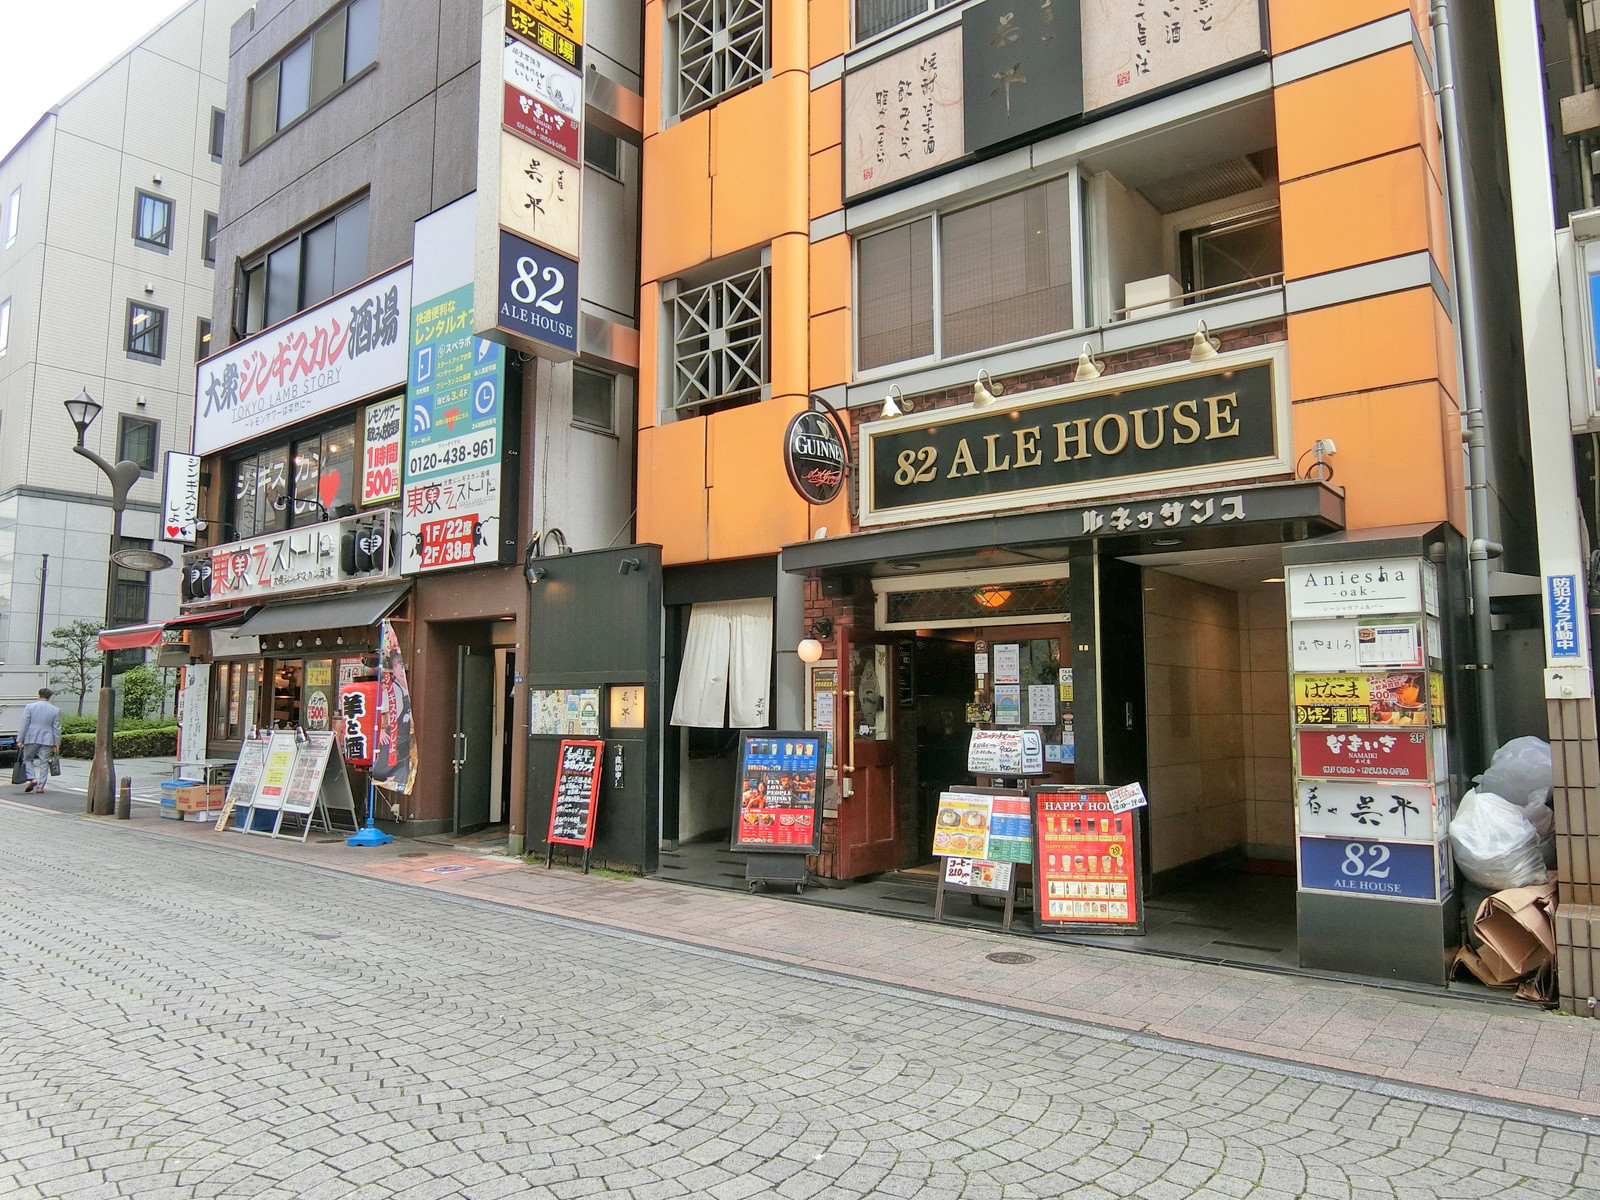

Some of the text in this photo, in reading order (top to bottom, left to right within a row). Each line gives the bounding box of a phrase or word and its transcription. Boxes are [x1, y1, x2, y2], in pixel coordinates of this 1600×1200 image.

[511, 6, 536, 27] レモン
[511, 18, 536, 38] サワー
[539, 25, 574, 62] 酒場
[510, 255, 565, 315] 82
[415, 300, 456, 327] 快適便利な
[500, 302, 574, 339] ALE HOUSE
[203, 284, 399, 418] 大衆ジンギスカン酒場
[232, 366, 342, 421] TOKYO LAMB STORY
[368, 404, 400, 425] レモンサワー
[367, 419, 400, 442] 飲み放題
[894, 392, 1241, 486] 82 ALE HOUSE
[367, 442, 398, 469] 1時間
[410, 438, 494, 474] 0120-438-961
[185, 457, 199, 523] ジンギスカン
[168, 501, 180, 523] しよ
[1082, 495, 1247, 536] ルネッサンス
[425, 519, 472, 543] 1F/22席
[424, 542, 471, 565] 2F/38席
[1304, 565, 1405, 588] Aniesha
[1552, 577, 1574, 650] 防犯カメラ作動中
[1305, 681, 1360, 698] はなこま
[1308, 707, 1330, 715] レモン
[1308, 714, 1331, 723] サワー
[1333, 708, 1368, 723] 酒場
[1326, 734, 1397, 754] なまいき
[1410, 733, 1424, 743] 3F
[1108, 787, 1128, 797] HAPPY
[1045, 801, 1113, 811] HAPPY HOU
[1341, 843, 1391, 879] 82
[1334, 879, 1402, 893] ALE HOUSE
